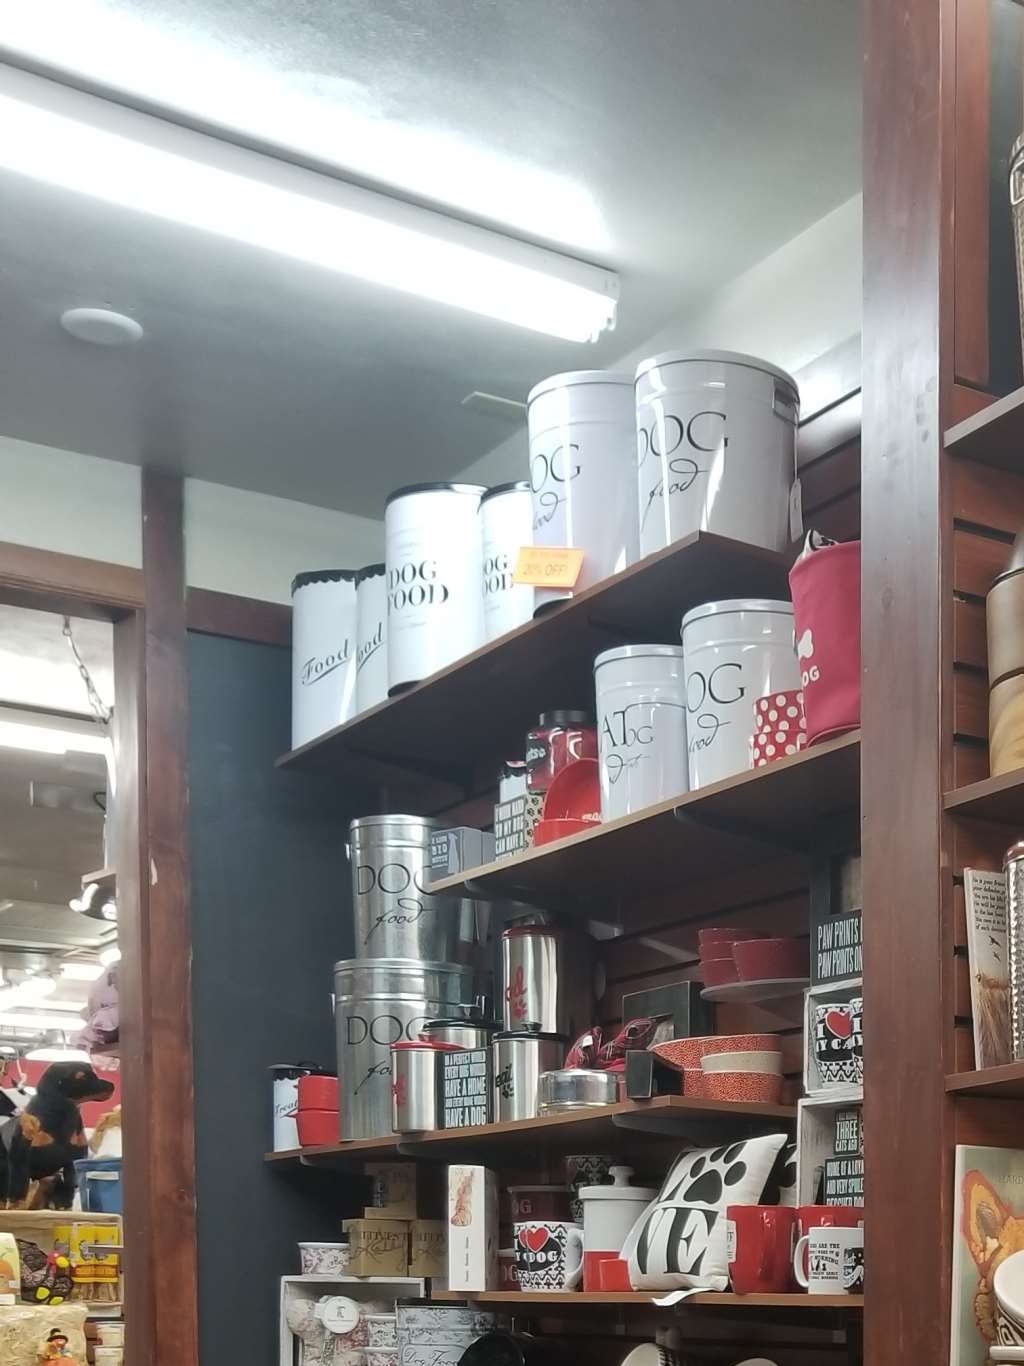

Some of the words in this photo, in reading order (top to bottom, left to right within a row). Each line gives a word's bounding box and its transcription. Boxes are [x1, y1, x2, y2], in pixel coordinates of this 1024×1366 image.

[532, 444, 580, 493] OG
[357, 622, 384, 662] ood
[302, 639, 349, 685] Food
[687, 663, 745, 713] OG
[818, 922, 834, 951] PAW
[834, 918, 859, 948] PRINTS
[818, 950, 832, 978] PAW
[832, 946, 854, 976] PRINTS
[817, 1023, 824, 1038] I
[445, 1079, 461, 1097] HAVE
[462, 1078, 468, 1096] A
[468, 1077, 486, 1095] HOME
[445, 1108, 463, 1128] HAVE
[464, 1107, 469, 1126] A
[471, 1106, 486, 1126] DOG
[836, 1120, 858, 1139] THREE
[835, 1140, 847, 1152] CATS
[848, 1139, 858, 1151] AGO
[827, 1161, 840, 1177] HOME
[841, 1161, 847, 1176] OF
[848, 1160, 852, 1175] A
[837, 1179, 847, 1194] VERY
